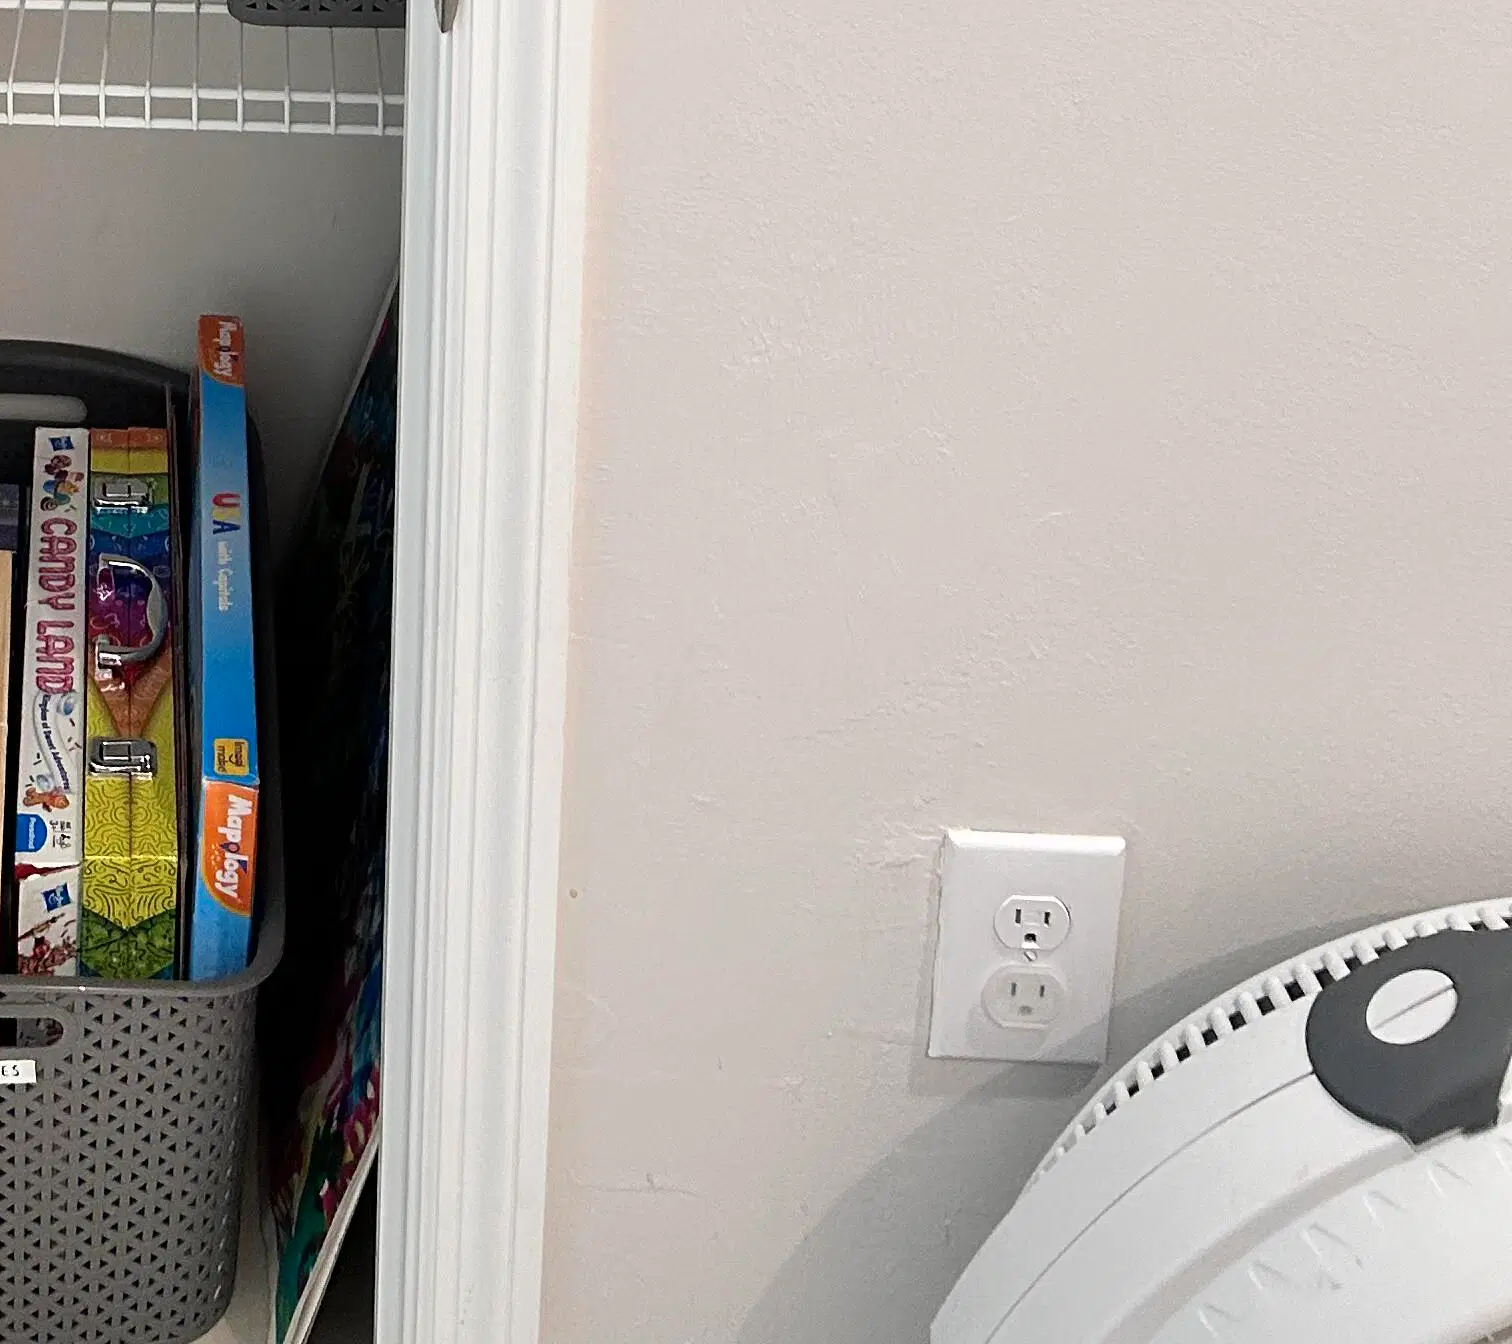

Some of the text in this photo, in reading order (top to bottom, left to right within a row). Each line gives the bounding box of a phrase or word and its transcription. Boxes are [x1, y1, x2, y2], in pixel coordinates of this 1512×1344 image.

[212, 493, 241, 535] USA
[36, 517, 78, 695] CANDY LAND
[52, 752, 70, 791] Adventures
